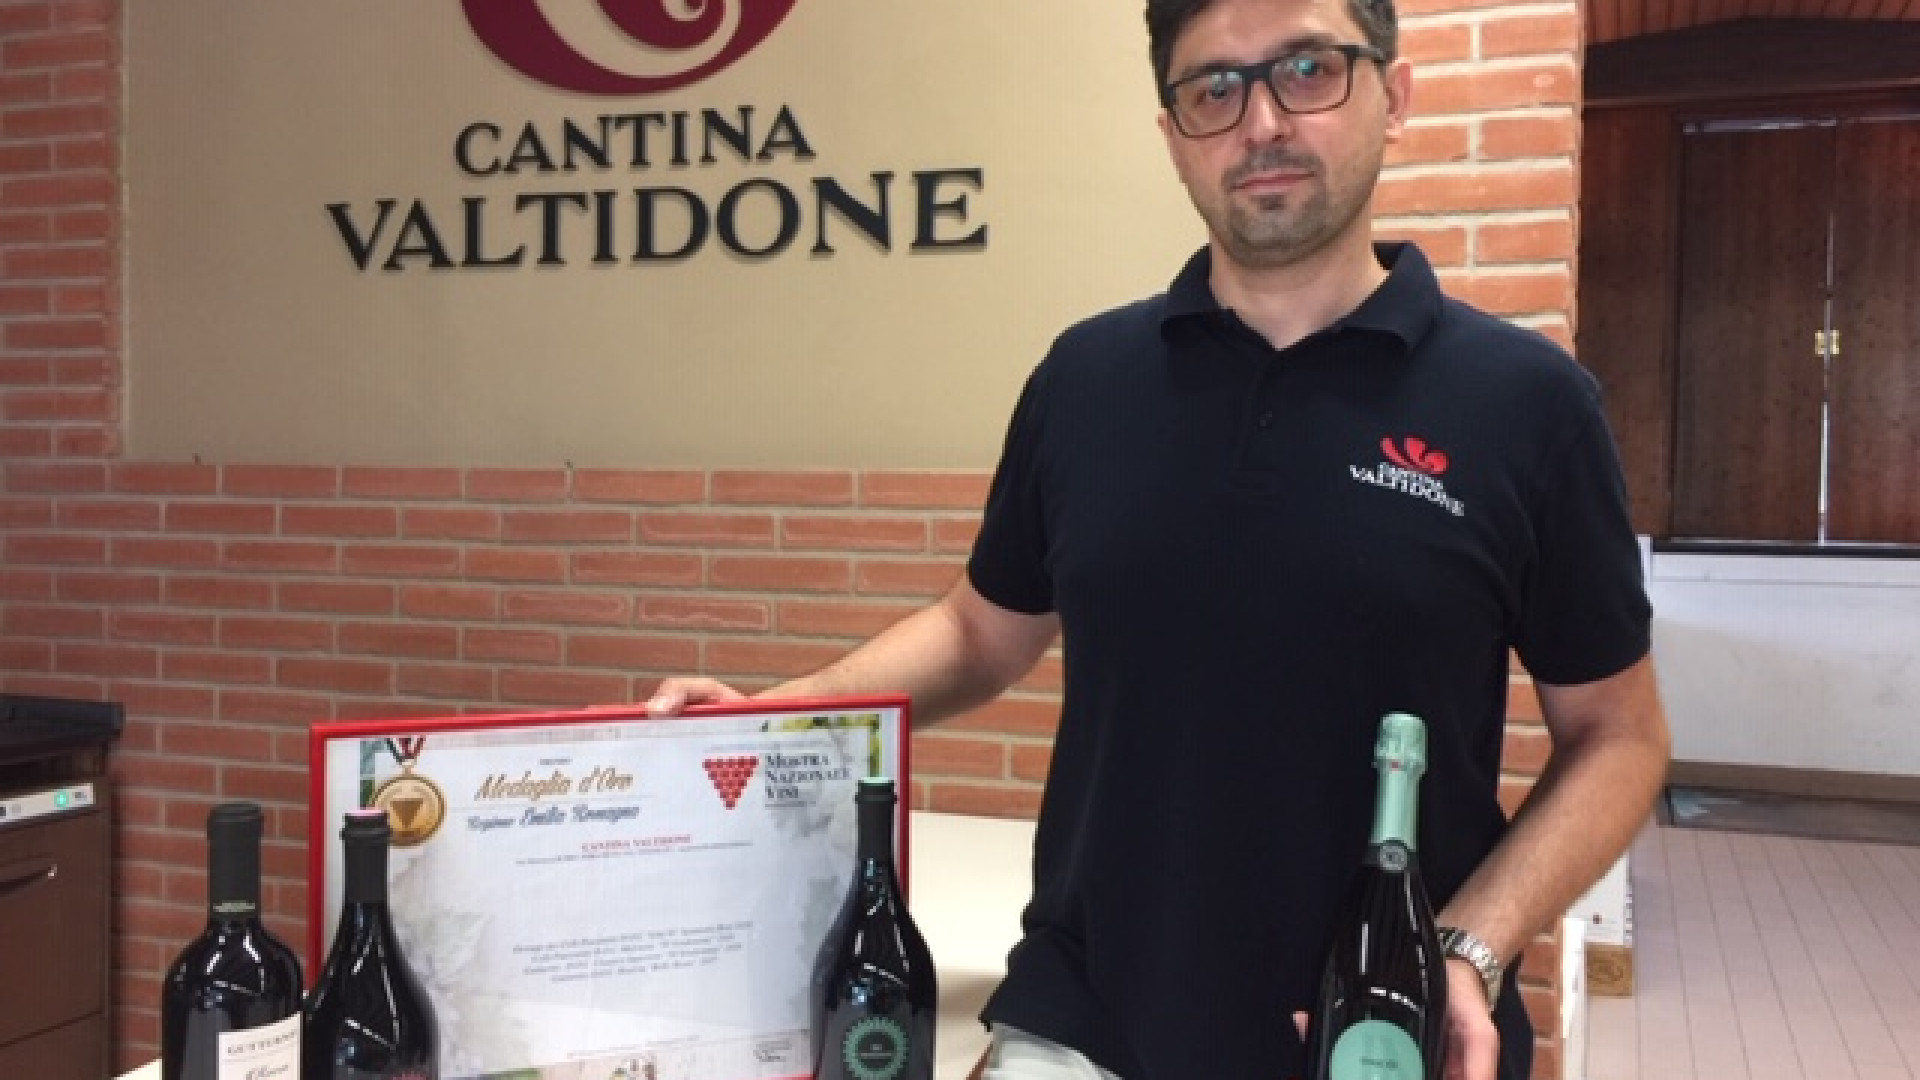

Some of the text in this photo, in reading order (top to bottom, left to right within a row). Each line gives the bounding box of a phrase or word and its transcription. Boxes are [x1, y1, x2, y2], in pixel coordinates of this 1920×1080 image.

[454, 104, 815, 176] CANTINA
[326, 167, 988, 272] VALTIDONE
[1349, 465, 1465, 516] VALTIDONE
[474, 769, 572, 801] Medaglia
